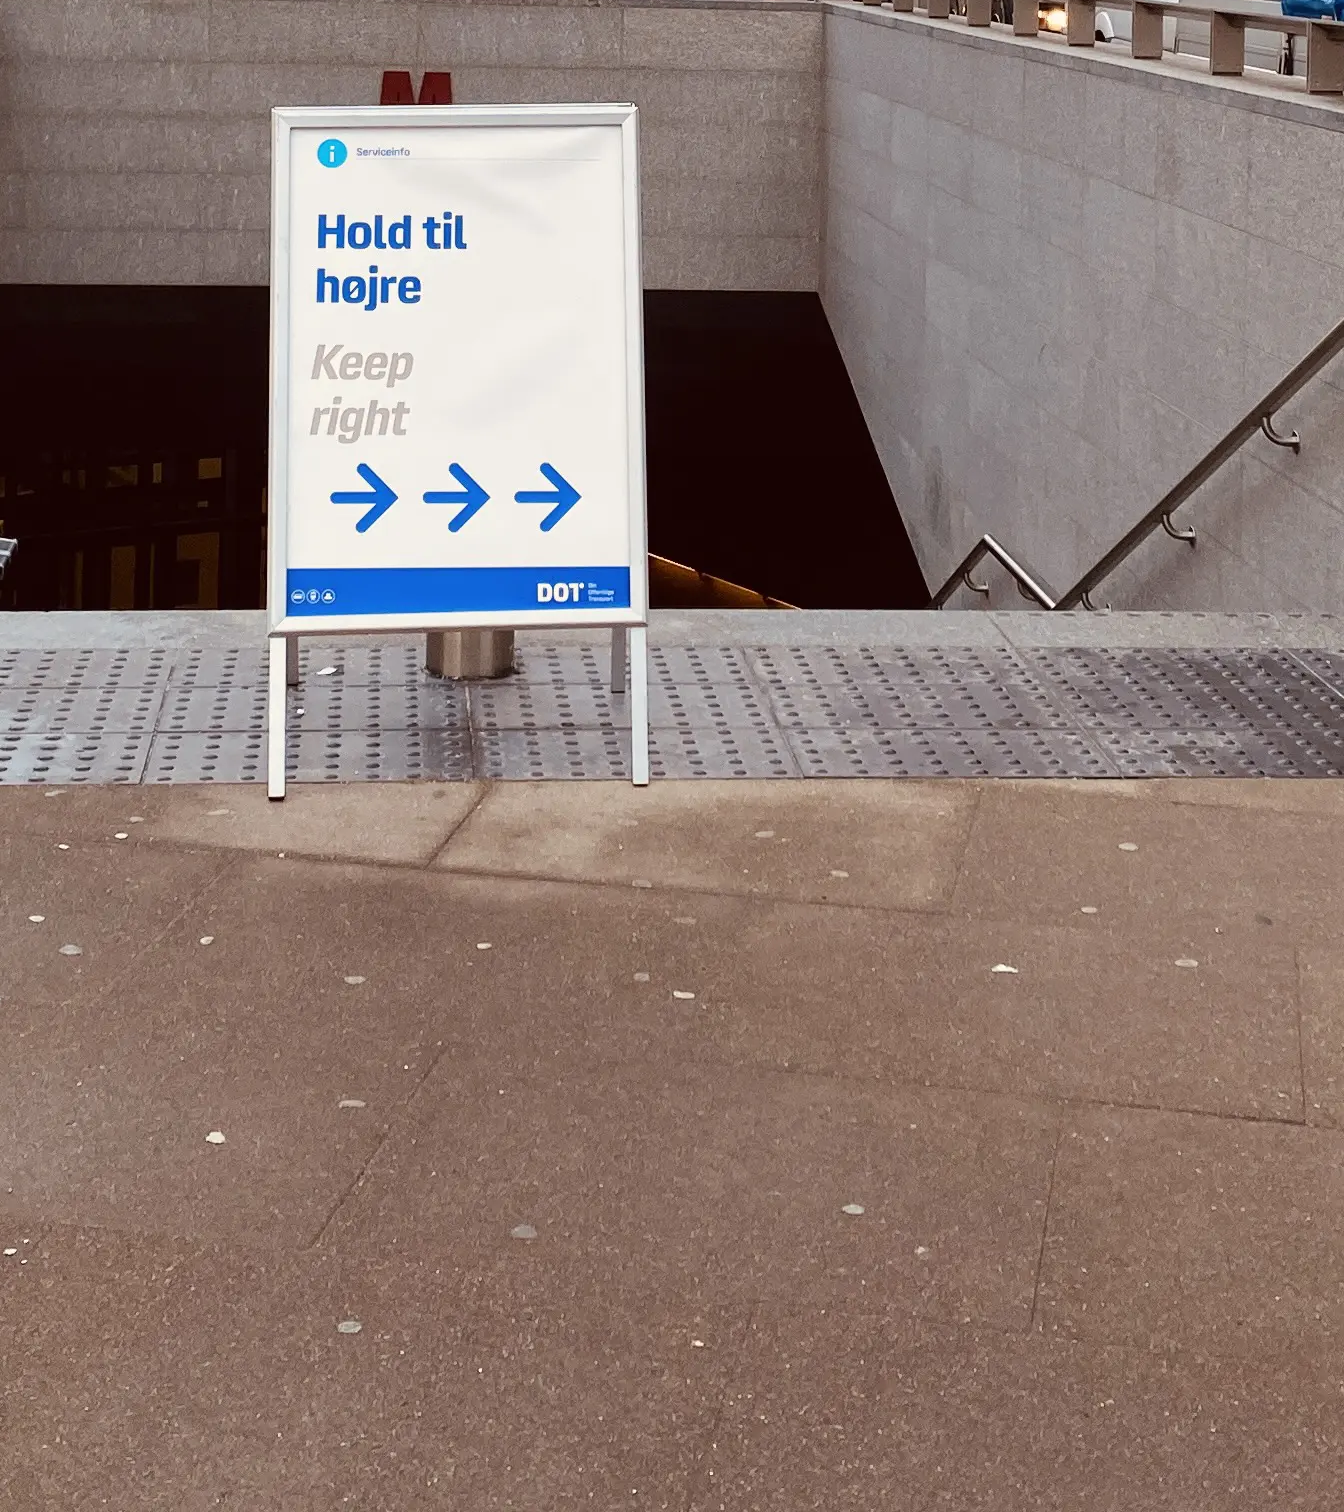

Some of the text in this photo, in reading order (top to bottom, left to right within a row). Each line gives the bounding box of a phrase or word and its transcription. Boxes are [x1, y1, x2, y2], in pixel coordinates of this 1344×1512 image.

[356, 147, 411, 157] Serviceinfo
[317, 211, 467, 250] Hold til
[316, 265, 422, 311] højre
[311, 344, 414, 388] Keep
[310, 396, 411, 444] right
[537, 582, 581, 603] DOT
